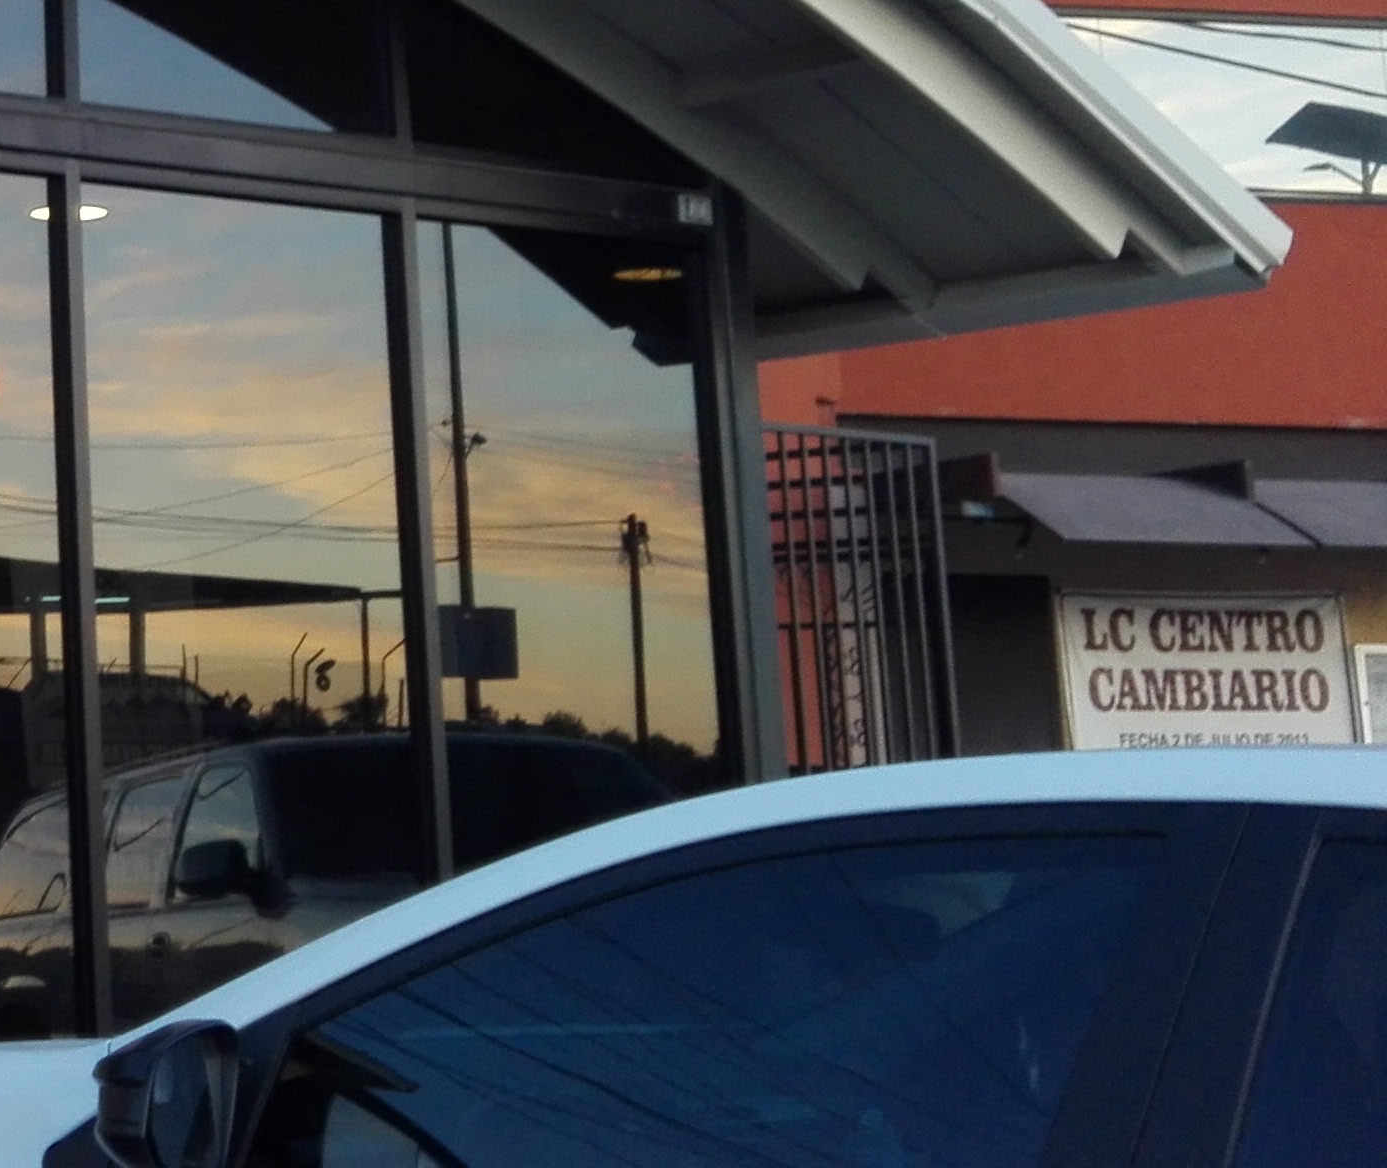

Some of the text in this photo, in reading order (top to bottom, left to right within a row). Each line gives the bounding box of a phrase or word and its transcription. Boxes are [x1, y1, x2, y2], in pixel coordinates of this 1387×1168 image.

[1080, 607, 1326, 653] LC CENTRO
[1088, 667, 1331, 714] CAMBIARIO
[1118, 732, 1170, 749] FECHA
